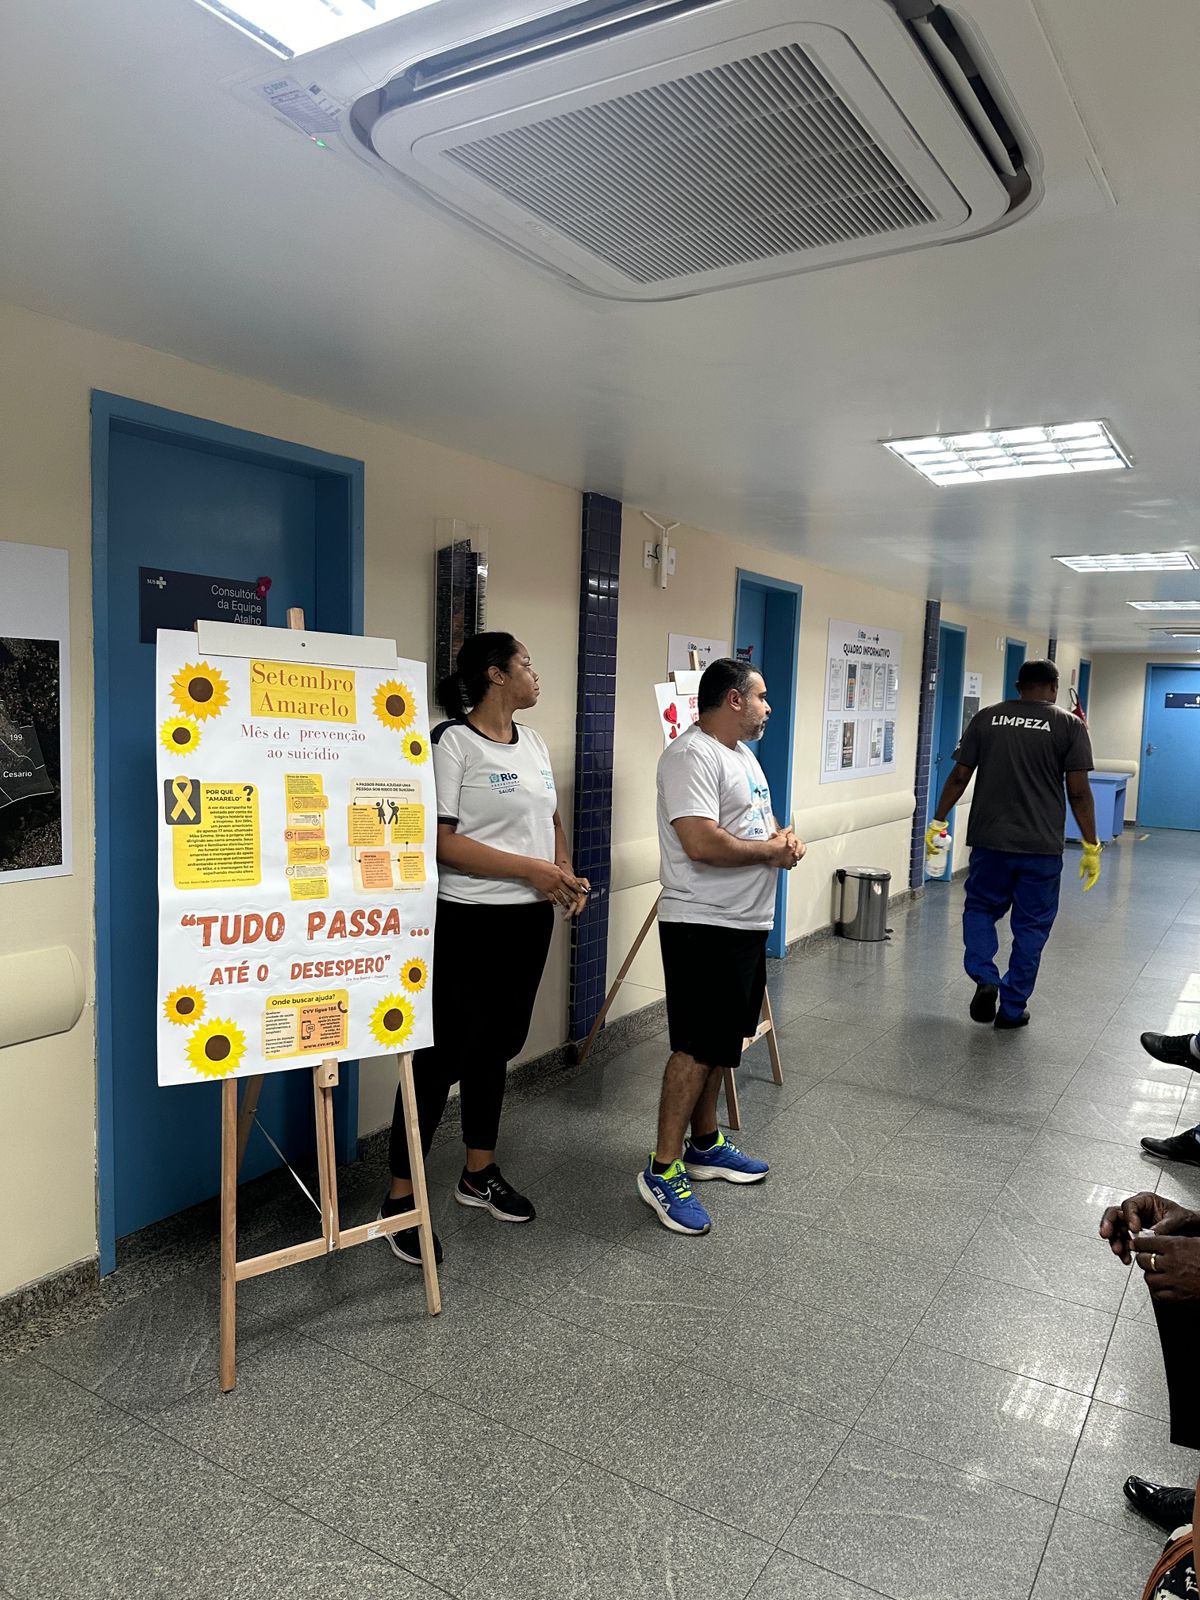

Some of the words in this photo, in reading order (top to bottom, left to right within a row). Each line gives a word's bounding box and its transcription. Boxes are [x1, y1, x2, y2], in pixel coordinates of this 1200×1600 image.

[218, 600, 229, 610] da
[232, 600, 262, 613] Equipe
[234, 614, 262, 626] Atalho
[843, 644, 862, 656] QUADRO
[862, 645, 890, 658] INFORMATIVO
[252, 662, 354, 693] Setembro
[259, 692, 349, 718] Amarelo
[992, 716, 1051, 732] LIMPEZA
[240, 724, 269, 739] Mês
[273, 726, 290, 740] de
[300, 728, 366, 743] prevenção
[267, 749, 283, 759] ao
[287, 746, 340, 760] suicídio
[500, 772, 518, 781] Rio
[242, 785, 254, 801] ?
[307, 908, 401, 940] PASSA
[210, 960, 249, 986] ATÉ
[256, 964, 269, 982] O
[315, 994, 336, 1002] ajuda?
[652, 1186, 672, 1212] FILA
